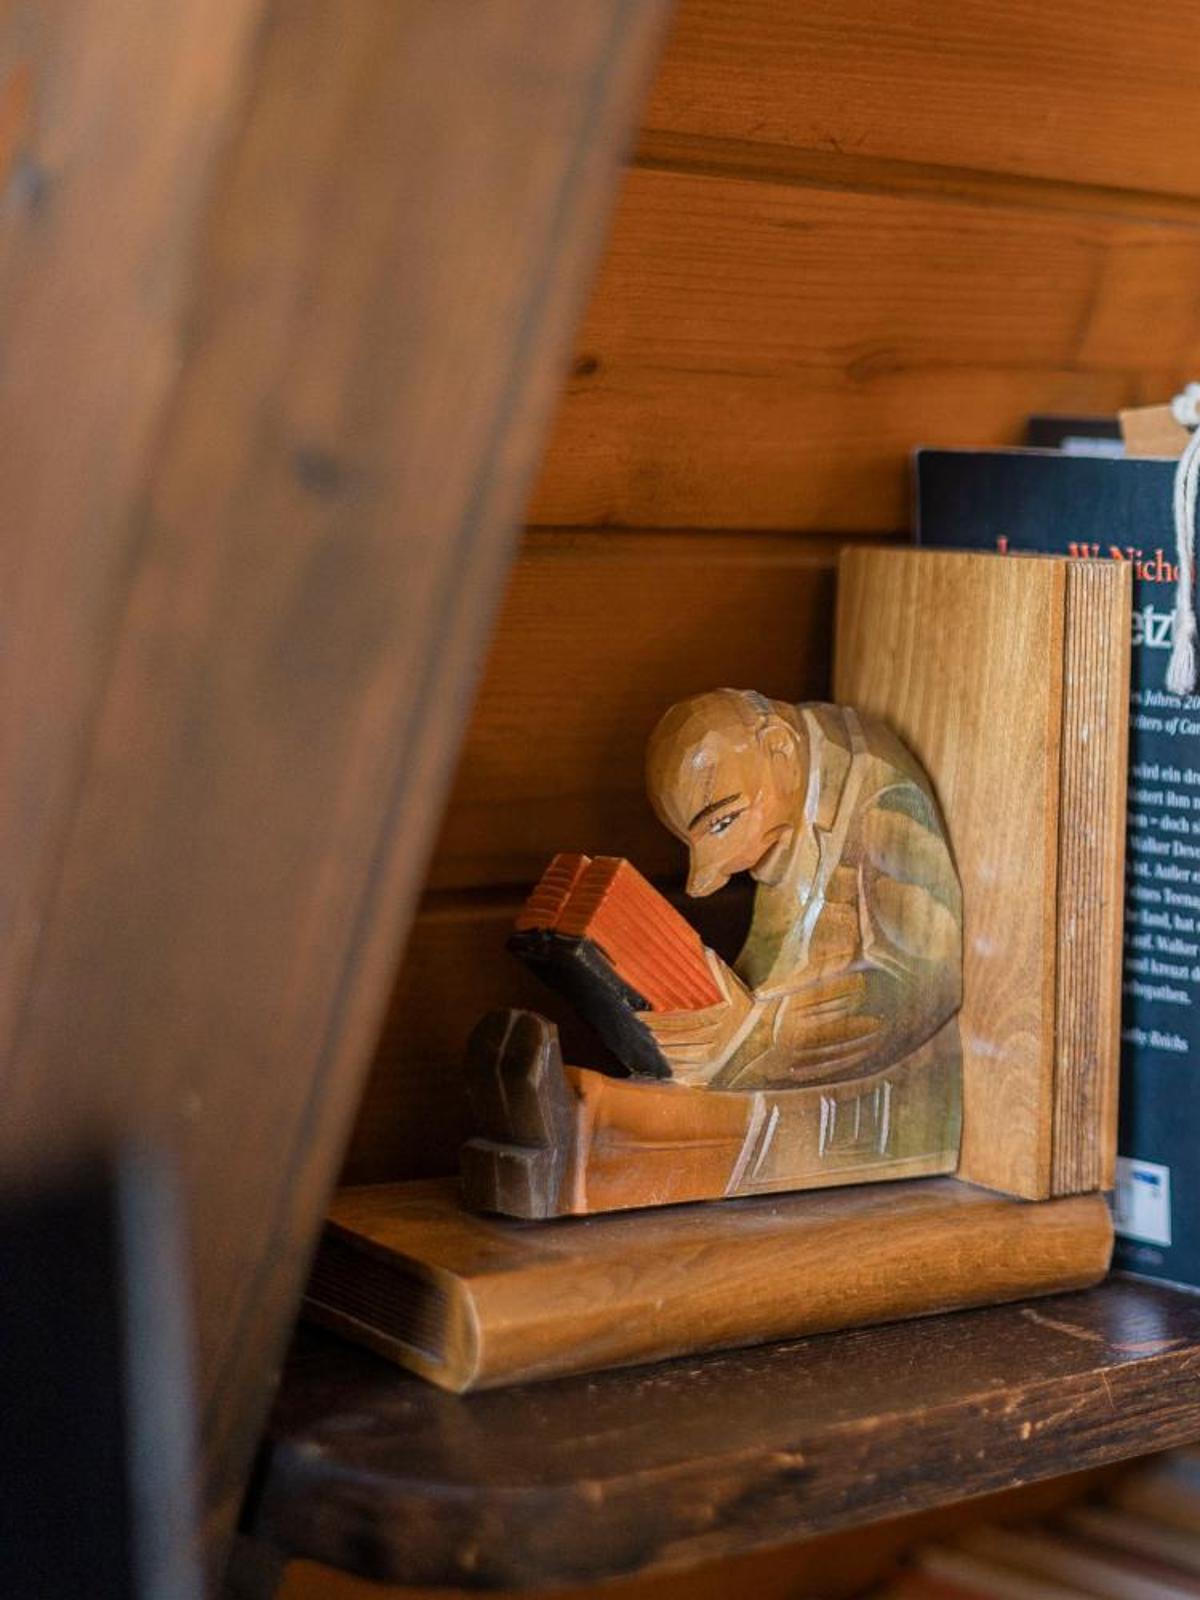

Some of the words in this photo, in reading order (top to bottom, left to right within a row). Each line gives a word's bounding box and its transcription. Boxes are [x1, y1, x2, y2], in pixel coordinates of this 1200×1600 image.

[1165, 717, 1180, 736] of
[1161, 765, 1181, 783] ein
[1160, 814, 1189, 833] doch
